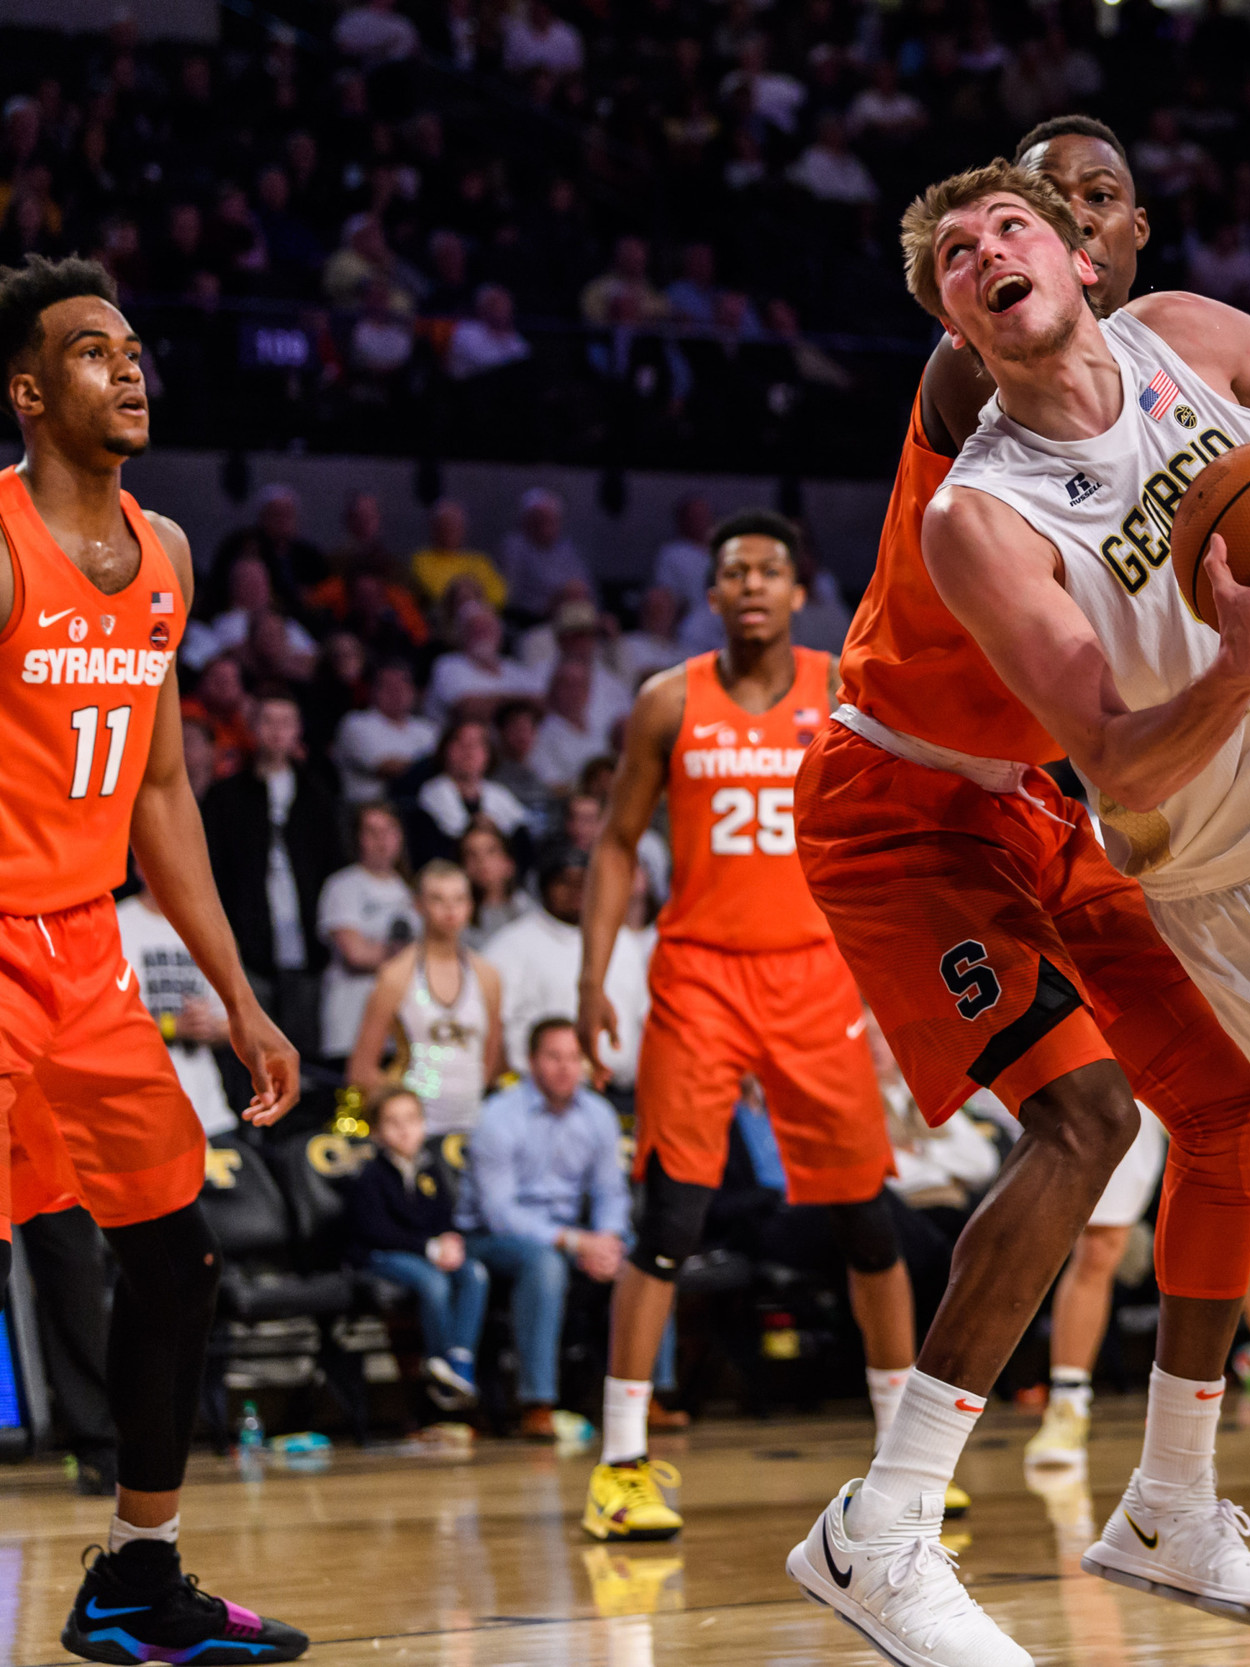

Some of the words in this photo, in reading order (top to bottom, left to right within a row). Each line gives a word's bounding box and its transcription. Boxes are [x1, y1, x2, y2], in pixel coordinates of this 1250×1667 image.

[1070, 482, 1102, 507] RUSSELL
[69, 705, 132, 799] 11
[711, 787, 797, 856] 25
[939, 939, 1002, 1021] S
